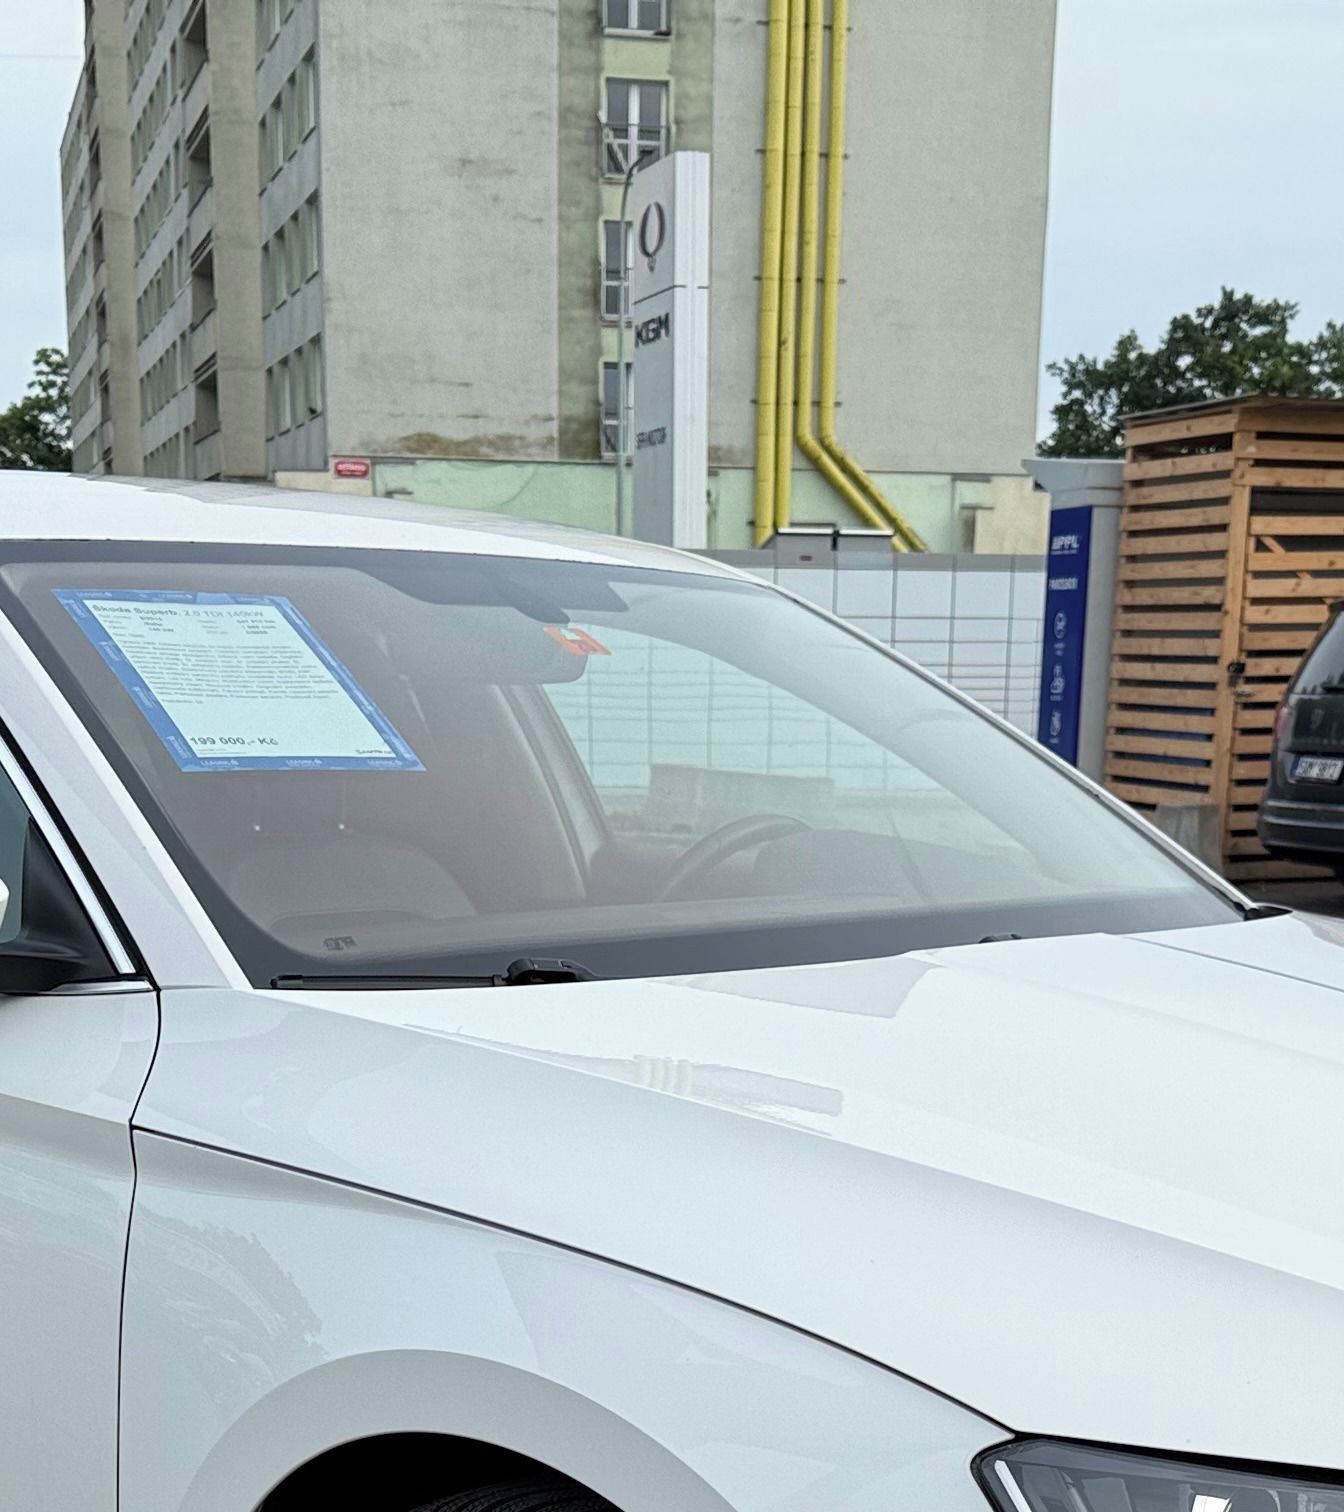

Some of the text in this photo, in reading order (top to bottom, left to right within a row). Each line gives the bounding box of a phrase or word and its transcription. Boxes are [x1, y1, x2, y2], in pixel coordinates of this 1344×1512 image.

[634, 312, 670, 348] KGM
[190, 736, 216, 746] 199
[259, 736, 279, 746] Kč
